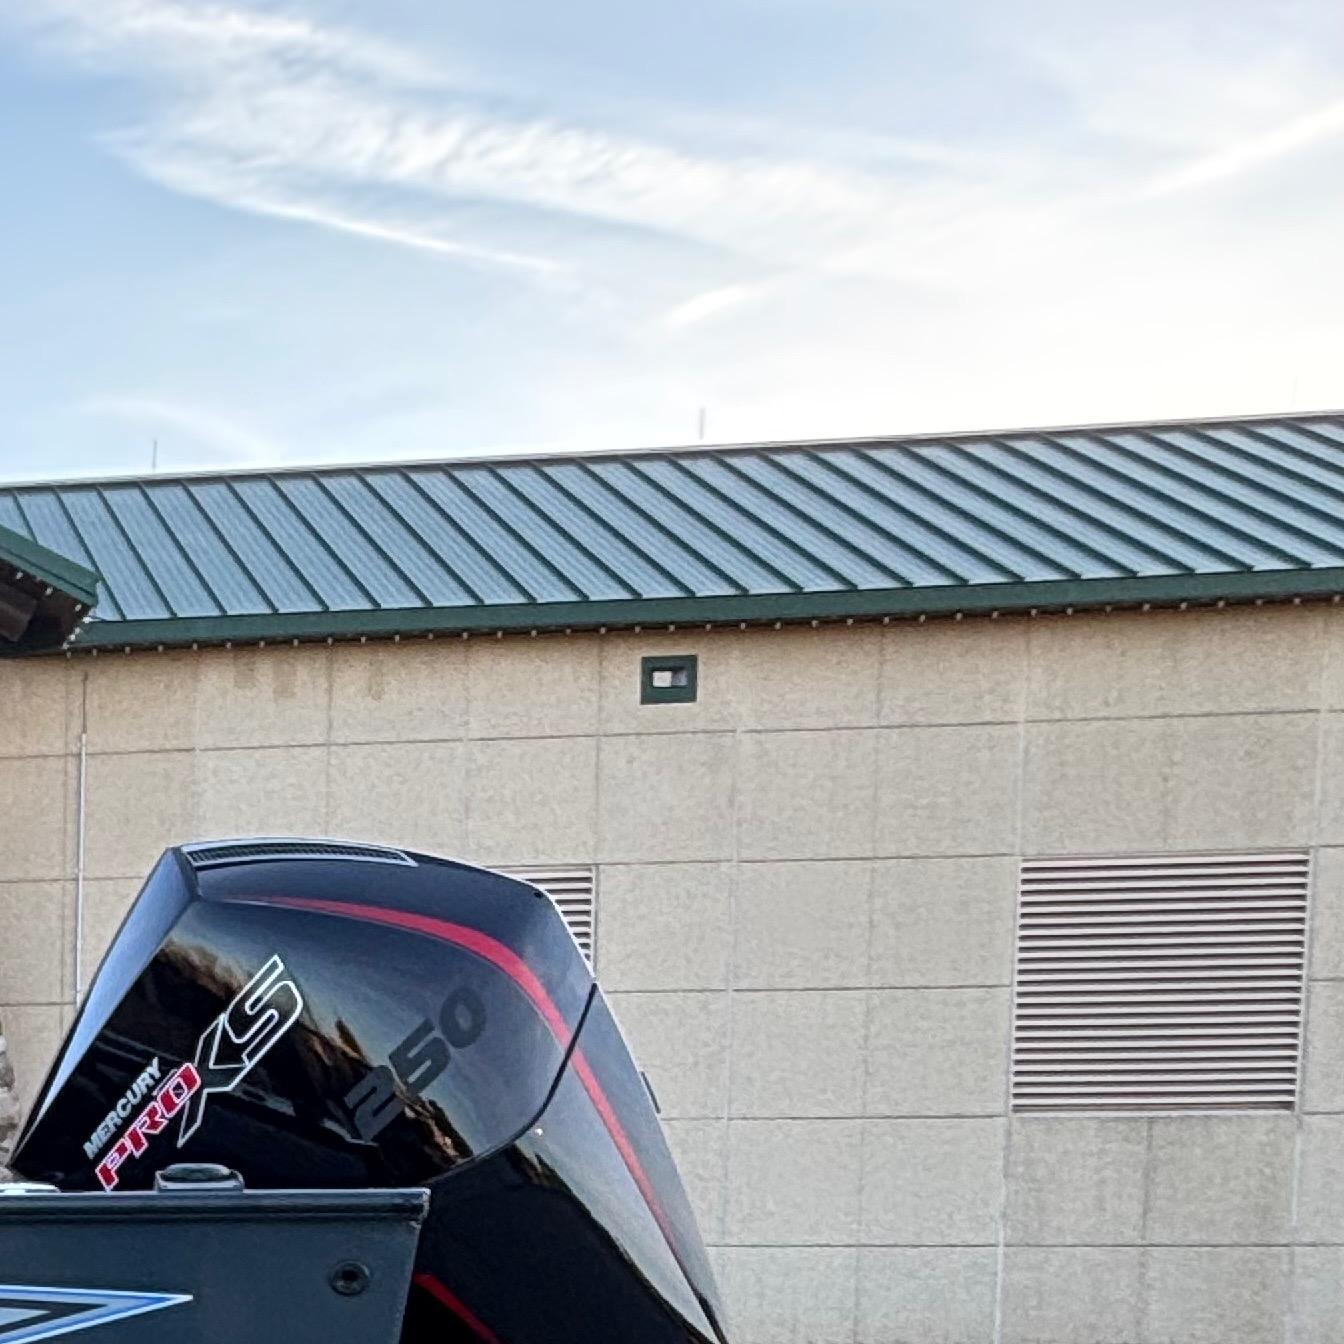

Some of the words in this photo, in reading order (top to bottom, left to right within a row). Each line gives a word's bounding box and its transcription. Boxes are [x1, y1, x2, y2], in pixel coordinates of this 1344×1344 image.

[82, 1056, 162, 1160] MERCURY
[94, 1062, 202, 1193] PRO
[177, 954, 304, 1149] XS
[343, 985, 487, 1141] 250
